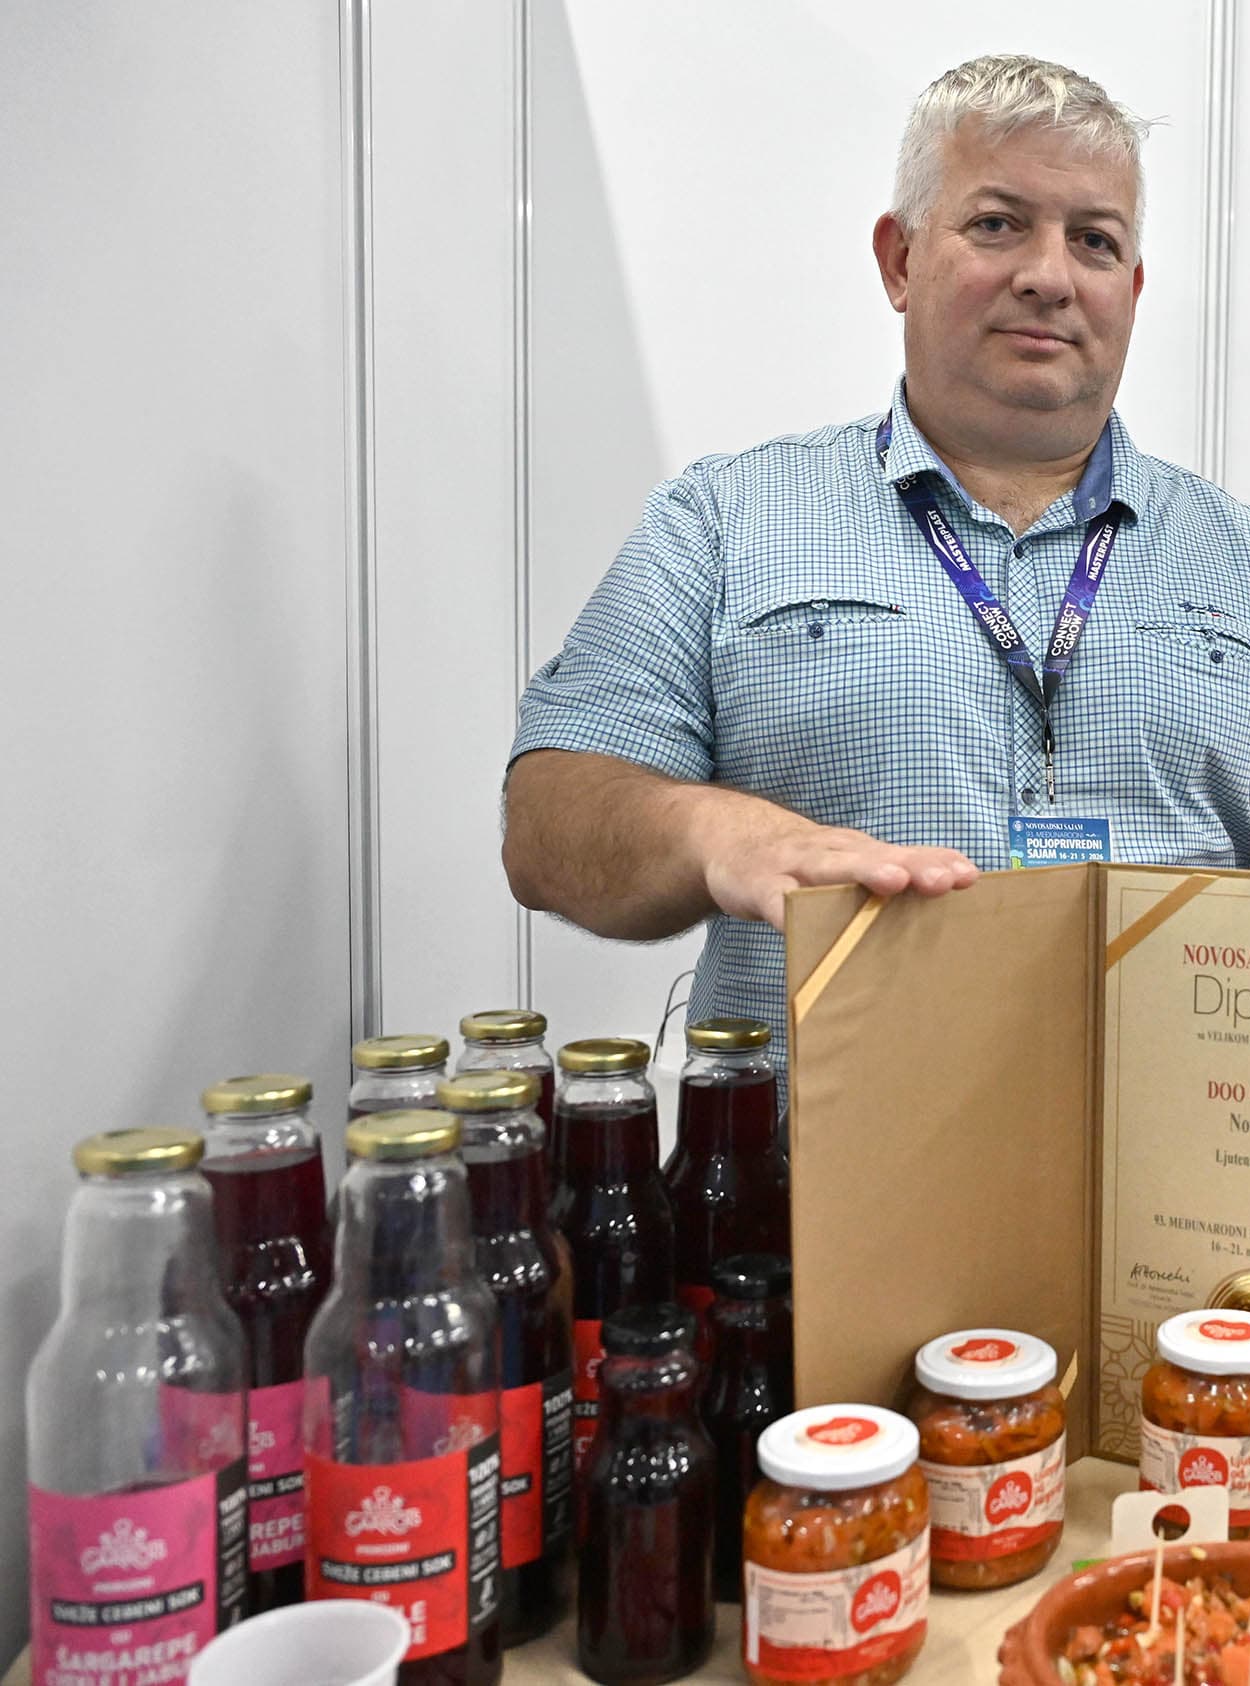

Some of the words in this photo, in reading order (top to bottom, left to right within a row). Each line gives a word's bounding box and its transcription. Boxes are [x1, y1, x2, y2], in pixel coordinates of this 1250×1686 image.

[928, 509, 971, 572] MASTERPLAST
[1088, 523, 1114, 582] MASTERPLAST
[973, 601, 1011, 650] CONNECT
[1051, 601, 1077, 657] CONNECT
[1026, 838, 1103, 850] POLJOPRIVREDNI
[1027, 849, 1057, 859] SAJAM
[1207, 1031, 1250, 1045] VELIKOM
[1208, 1080, 1246, 1103] DOO
